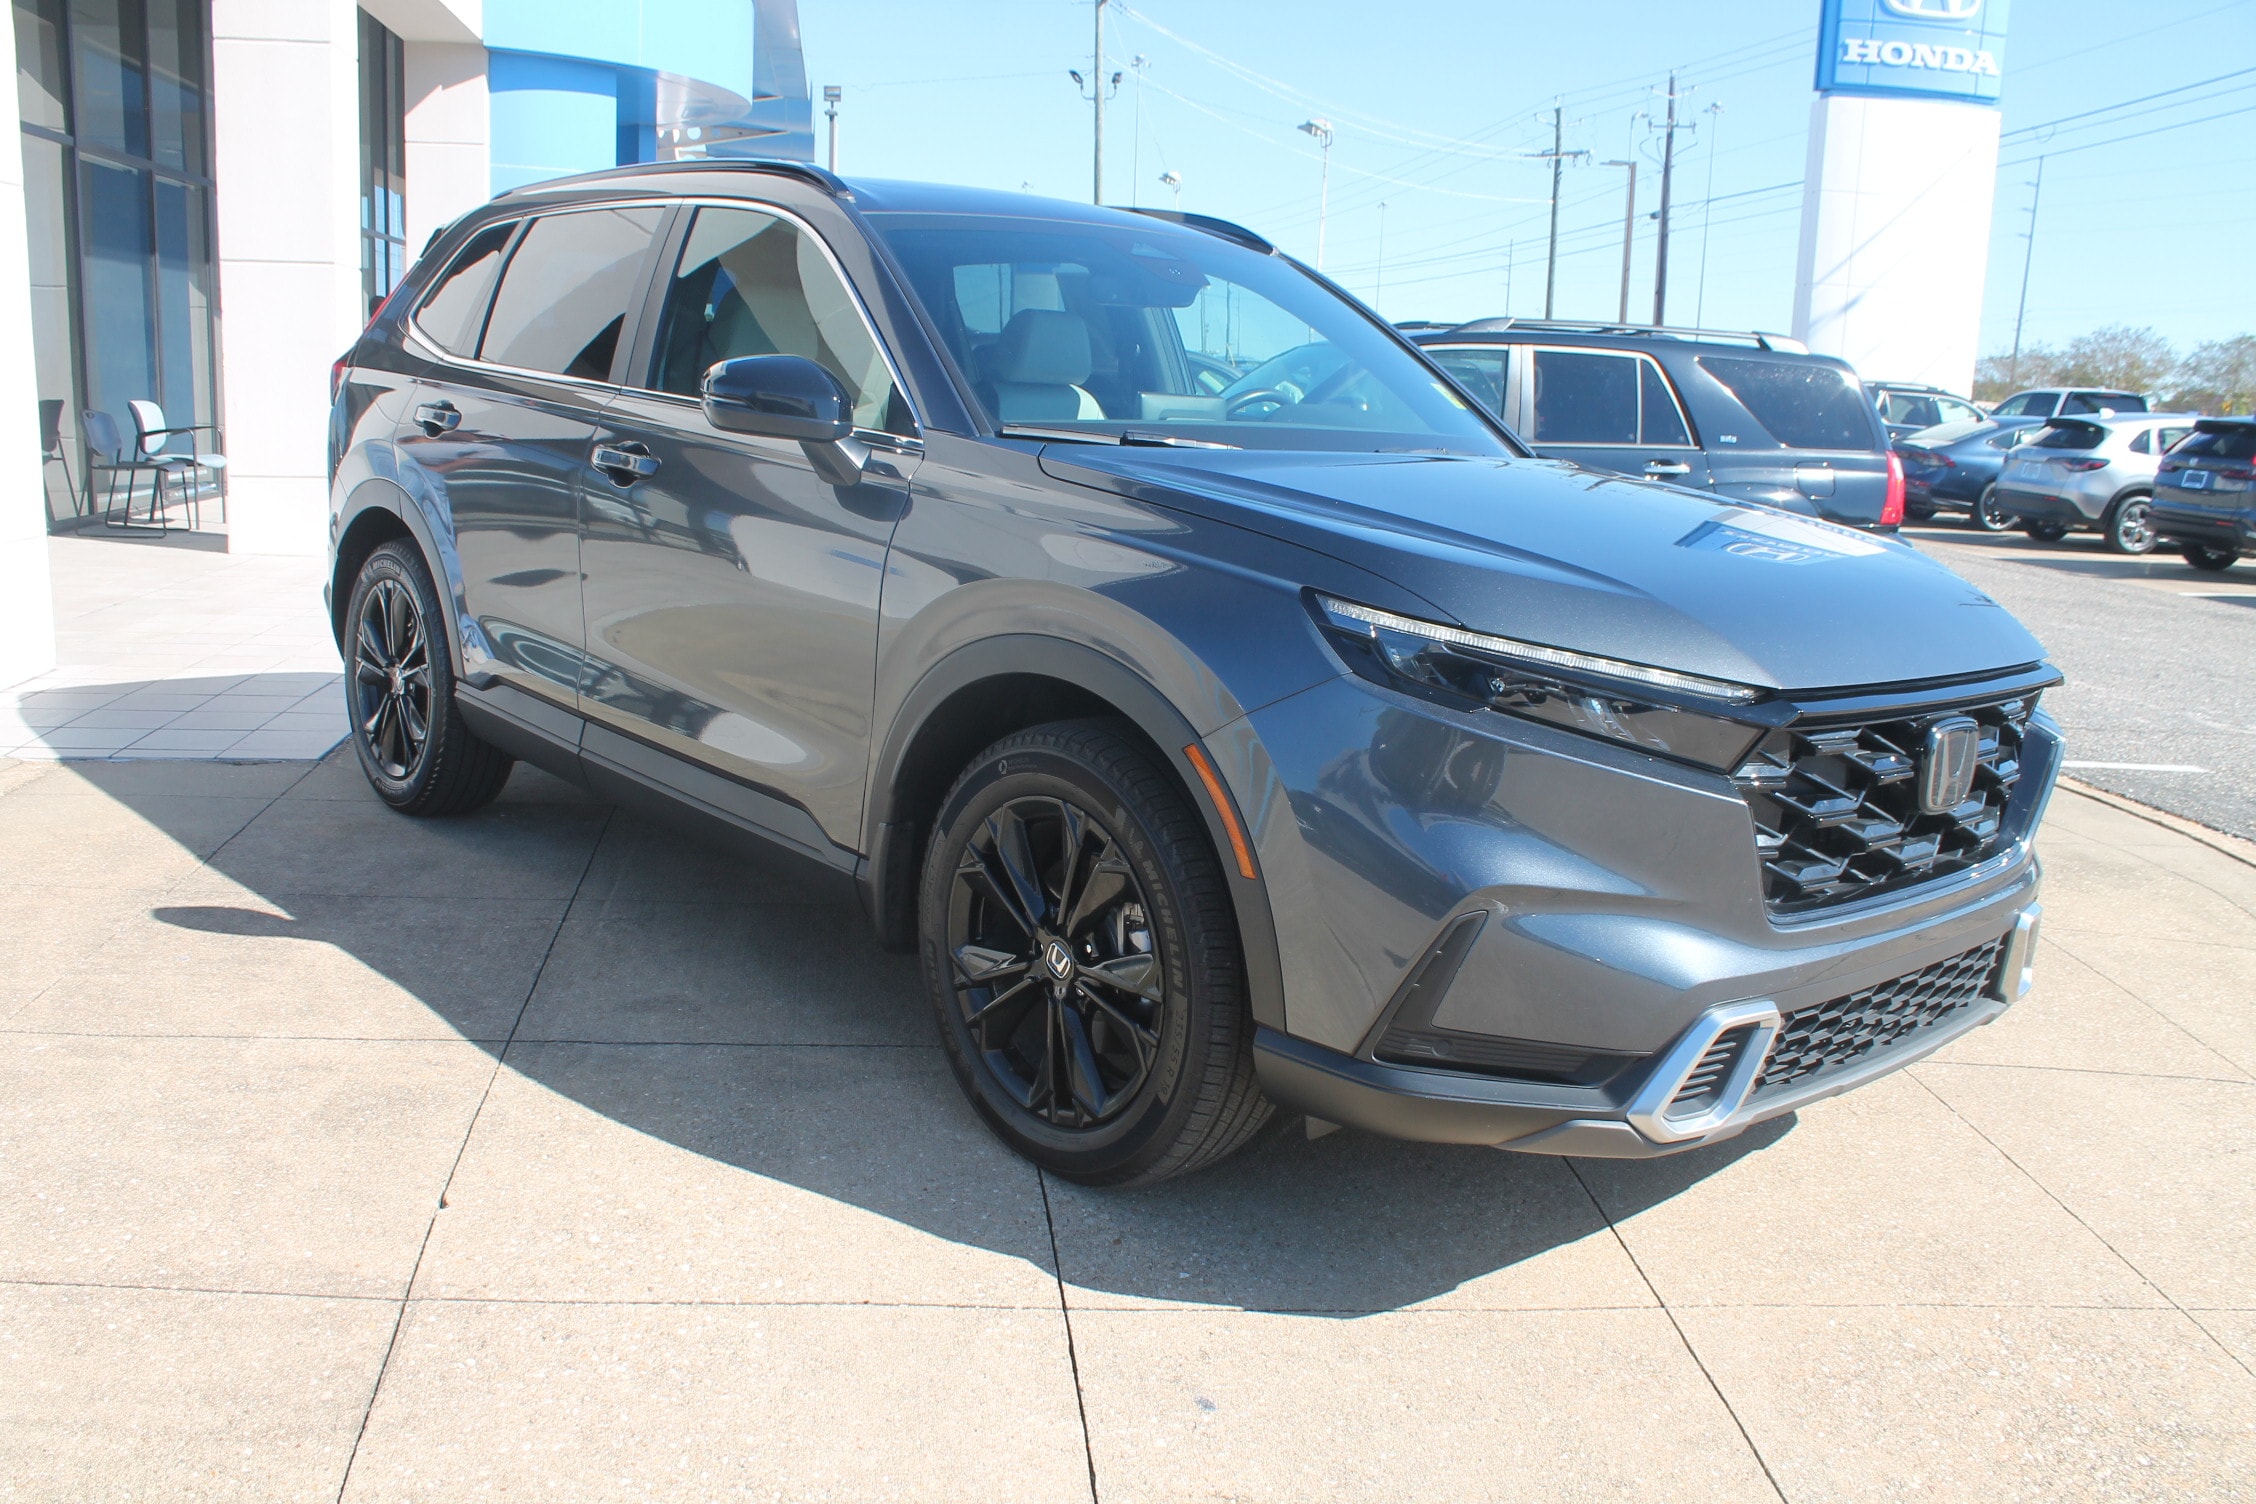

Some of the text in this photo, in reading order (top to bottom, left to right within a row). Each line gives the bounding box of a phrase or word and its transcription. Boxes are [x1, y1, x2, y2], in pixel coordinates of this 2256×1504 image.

[1842, 37, 2000, 75] HONDA
[372, 558, 401, 574] MICHELIN
[1142, 859, 1184, 989] MICHELIN
